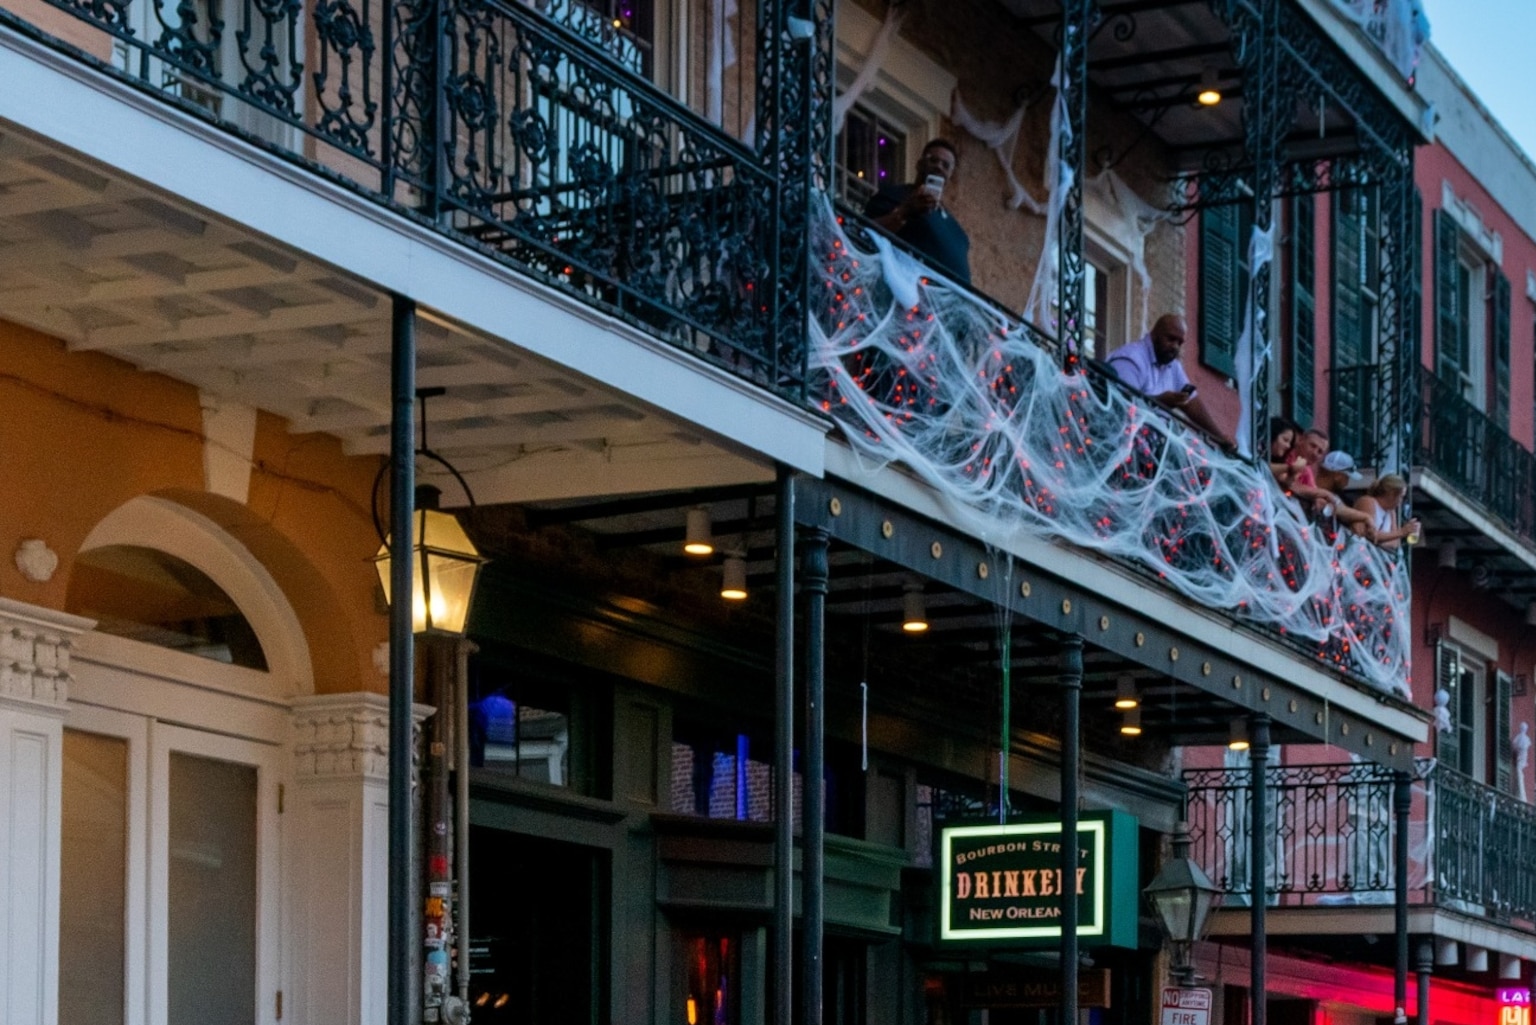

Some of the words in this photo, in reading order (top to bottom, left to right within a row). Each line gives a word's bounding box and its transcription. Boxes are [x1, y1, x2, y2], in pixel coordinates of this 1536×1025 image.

[1032, 840, 1088, 859] STRT
[969, 907, 1004, 920] NEW
[1006, 906, 1062, 919] ORLEAN
[1163, 990, 1179, 1006] NO
[1172, 1012, 1197, 1025] FIRE
